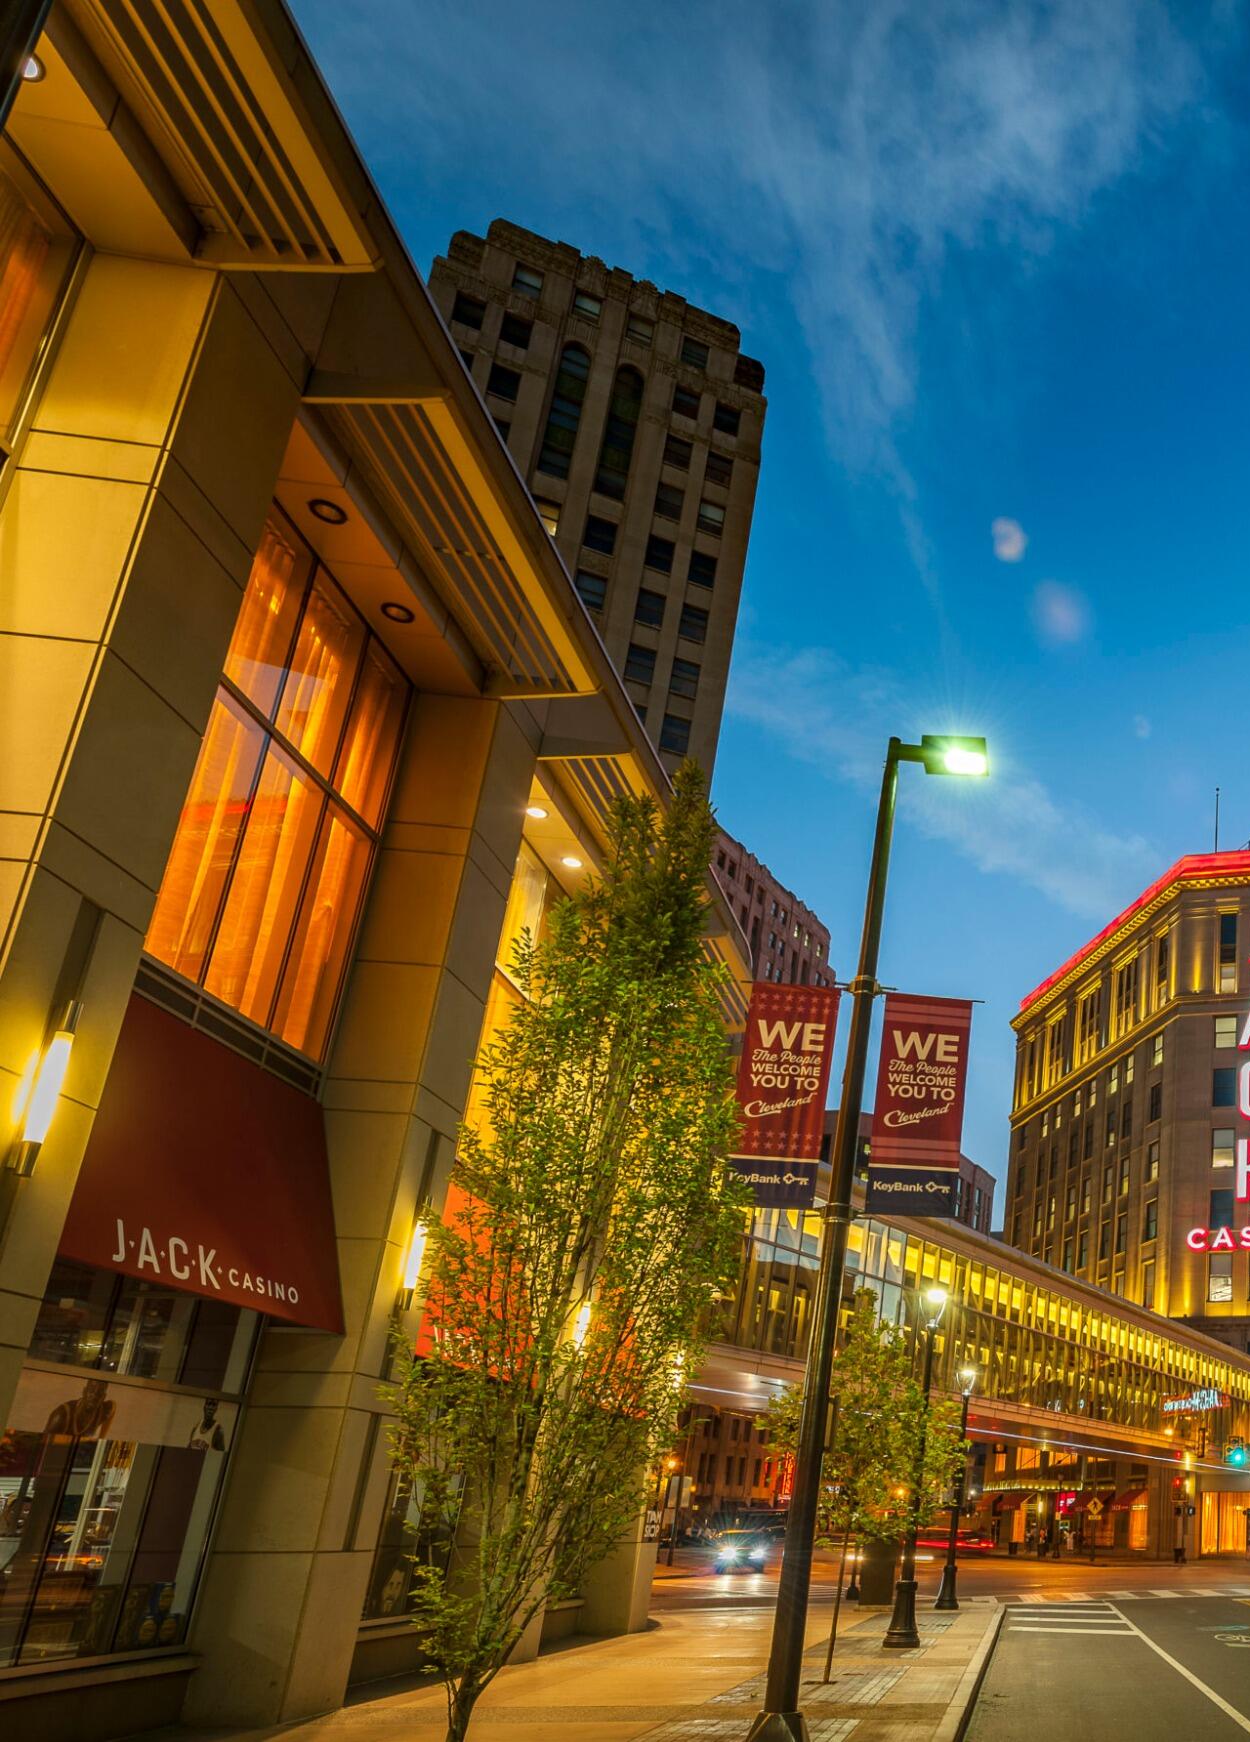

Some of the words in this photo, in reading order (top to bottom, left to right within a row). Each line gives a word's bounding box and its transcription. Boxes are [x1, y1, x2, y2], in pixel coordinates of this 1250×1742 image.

[758, 1019, 826, 1052] WE
[892, 1029, 960, 1063] WE
[751, 1048, 778, 1062] The
[780, 1050, 823, 1066] People
[751, 1062, 821, 1077] WELCOME
[888, 1059, 914, 1072] The
[916, 1061, 957, 1077] People
[750, 1073, 790, 1089] YOU
[794, 1077, 820, 1091] TO
[888, 1072, 956, 1087] WELCOME
[887, 1084, 926, 1099] YOU
[930, 1087, 956, 1101] TO
[744, 1093, 815, 1118] Cleveland
[883, 1103, 950, 1128] Cleveland
[873, 1180, 924, 1193] KeyBank
[112, 1218, 221, 1290] JACK
[228, 1268, 299, 1304] CASINO
